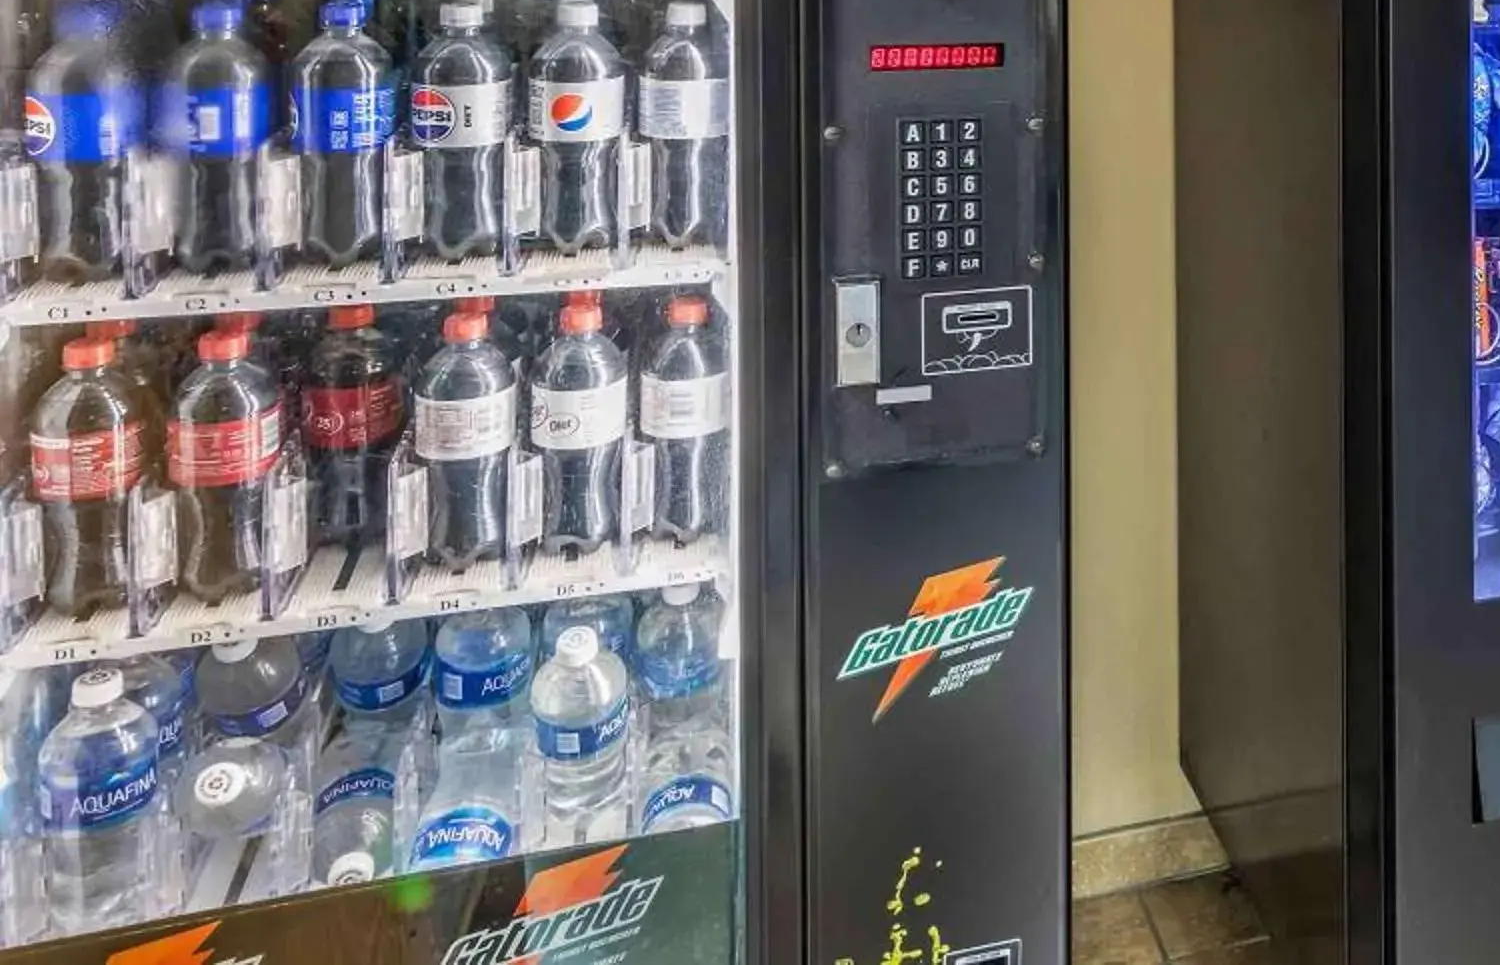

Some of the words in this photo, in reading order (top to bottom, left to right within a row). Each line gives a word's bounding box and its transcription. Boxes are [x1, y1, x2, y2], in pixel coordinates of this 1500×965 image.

[412, 106, 453, 124] PEPSI
[906, 124, 921, 142] A
[935, 123, 946, 141] 1
[964, 122, 976, 140] 2
[907, 151, 919, 169] B
[936, 150, 947, 168] 3
[964, 148, 975, 167] 4
[907, 178, 920, 196] C
[936, 176, 947, 194] 5
[964, 175, 975, 193] 6
[907, 205, 920, 223] D
[936, 204, 947, 221] 7
[964, 202, 976, 219] 8
[908, 232, 920, 250] E
[936, 230, 947, 248] 9
[964, 228, 975, 246] 0
[908, 259, 920, 277] F
[185, 297, 208, 312] C2
[314, 289, 336, 303] C3
[556, 584, 575, 596] D5
[439, 598, 460, 611] D4
[317, 614, 338, 628] D3
[191, 630, 213, 644] D2
[836, 586, 1034, 681] Gatorade
[54, 648, 76, 661] D1
[69, 767, 157, 819] AQUAFINA
[322, 775, 396, 804] QUAFINA
[428, 823, 506, 853] AQUAFINA
